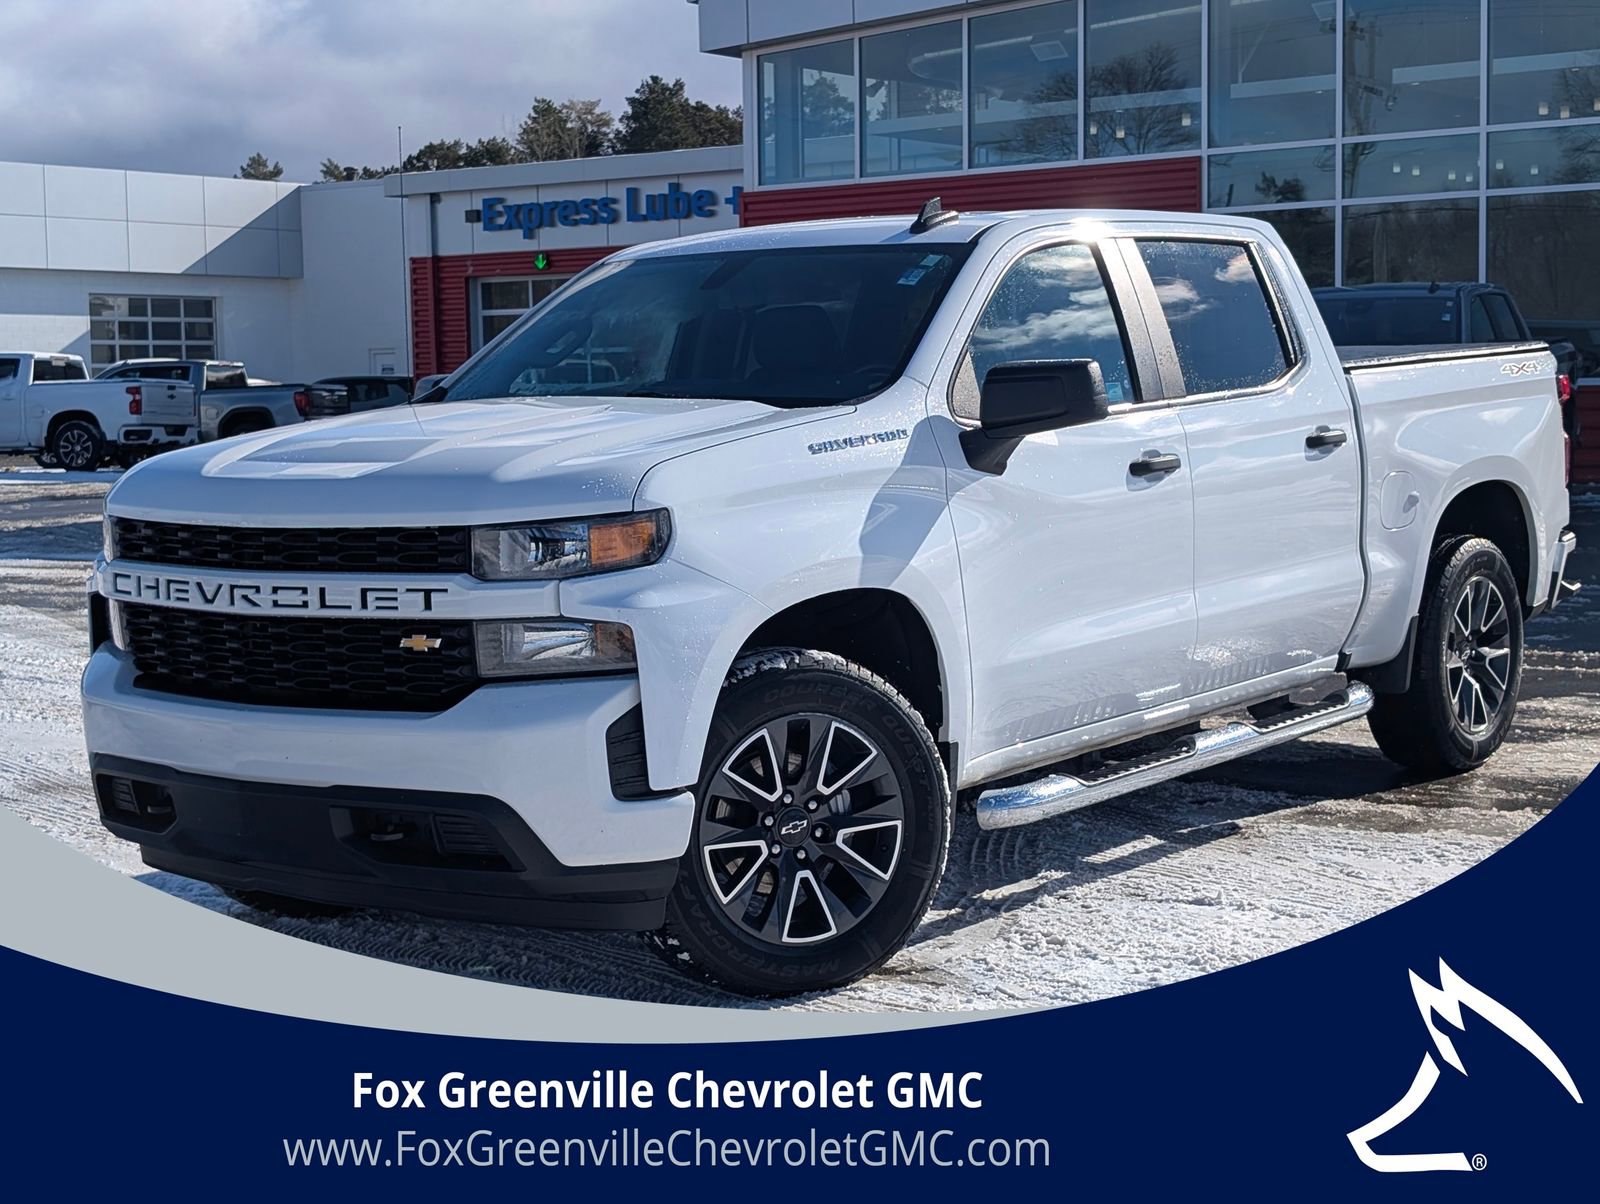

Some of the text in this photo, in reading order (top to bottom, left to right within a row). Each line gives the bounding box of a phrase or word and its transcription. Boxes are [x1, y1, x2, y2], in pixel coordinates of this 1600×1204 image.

[482, 196, 620, 239] Express
[626, 182, 716, 222] Lube
[112, 571, 449, 612] CHEVROLET
